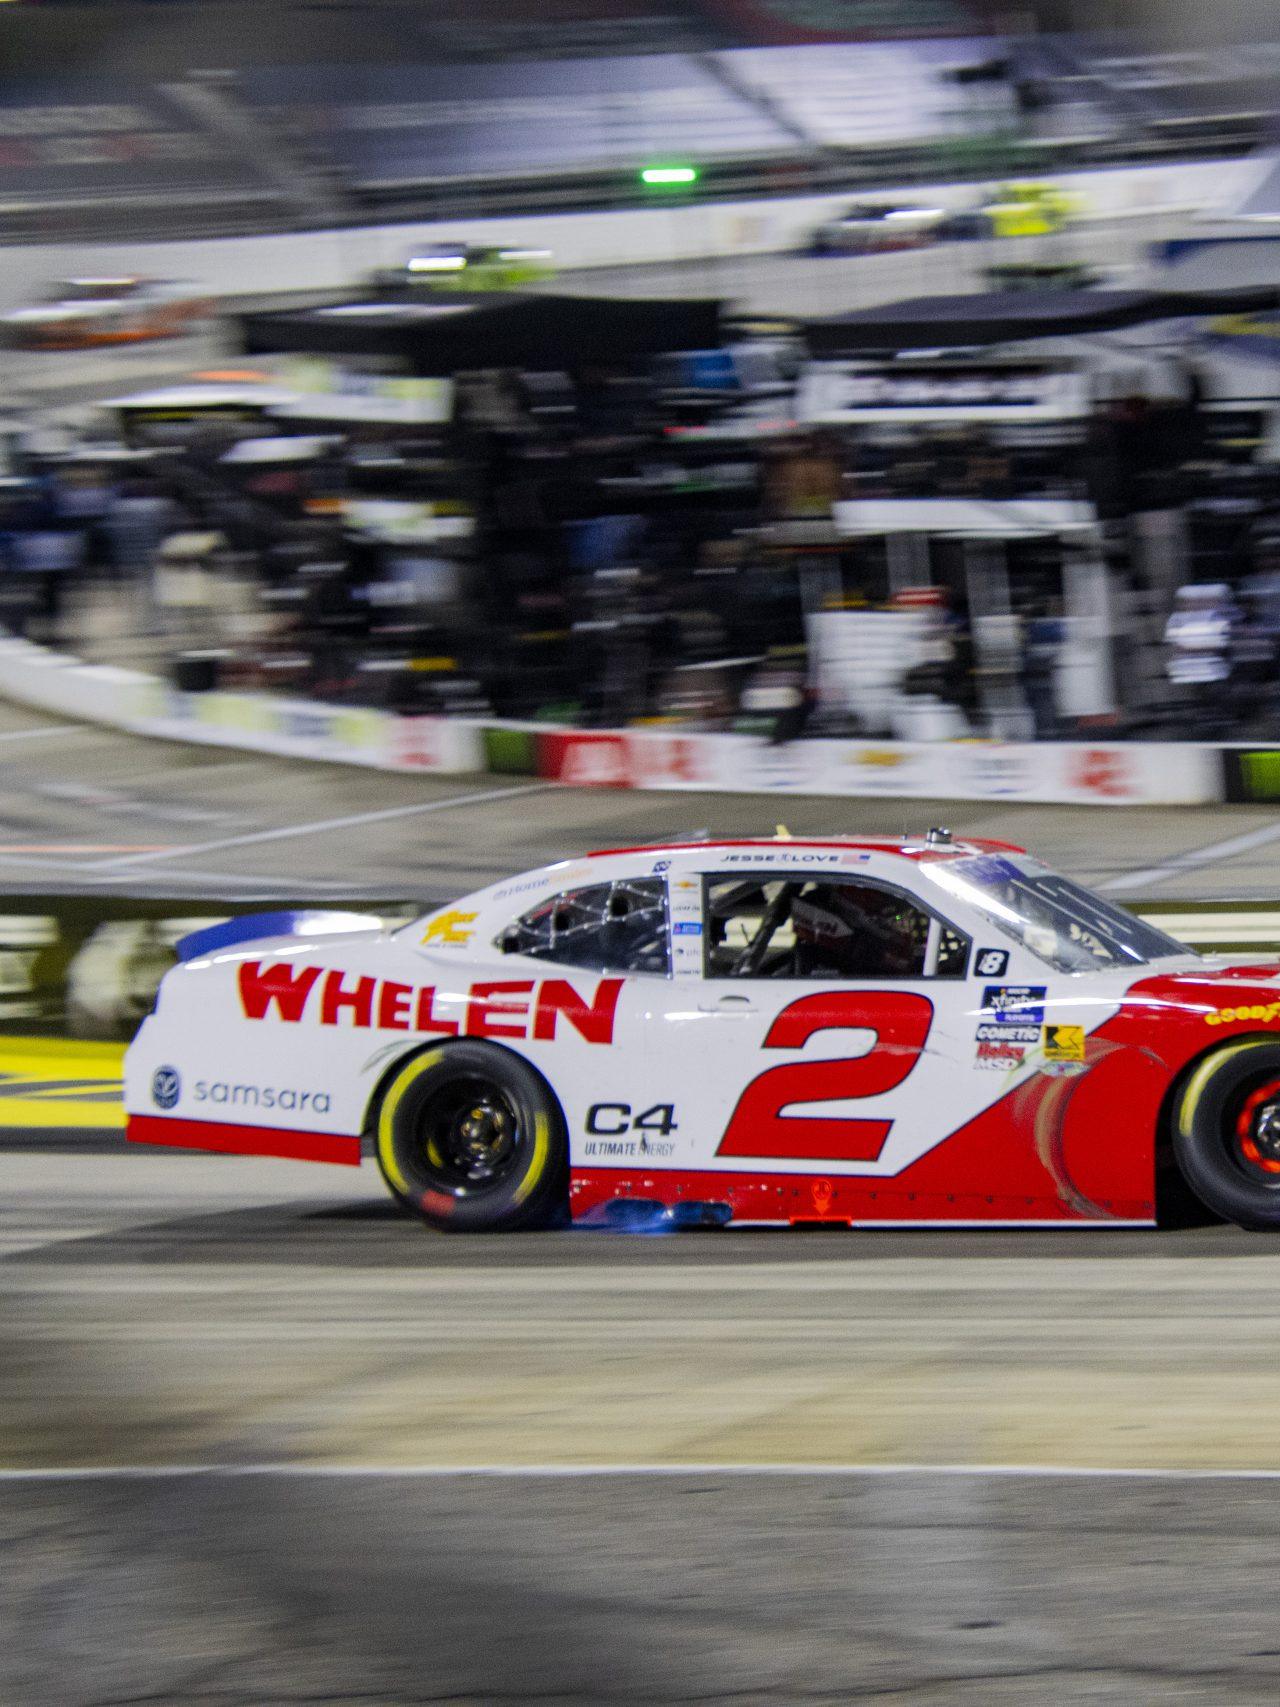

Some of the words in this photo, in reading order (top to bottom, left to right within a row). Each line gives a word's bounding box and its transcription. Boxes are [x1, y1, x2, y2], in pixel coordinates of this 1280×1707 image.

[720, 854, 775, 863] JESSE
[791, 854, 840, 863] LOVE
[235, 960, 627, 1046] WHELEN
[714, 989, 935, 1162] 2
[193, 1080, 331, 1114] samsara
[584, 1102, 679, 1137] C4
[584, 1142, 637, 1157] ULTIMATE
